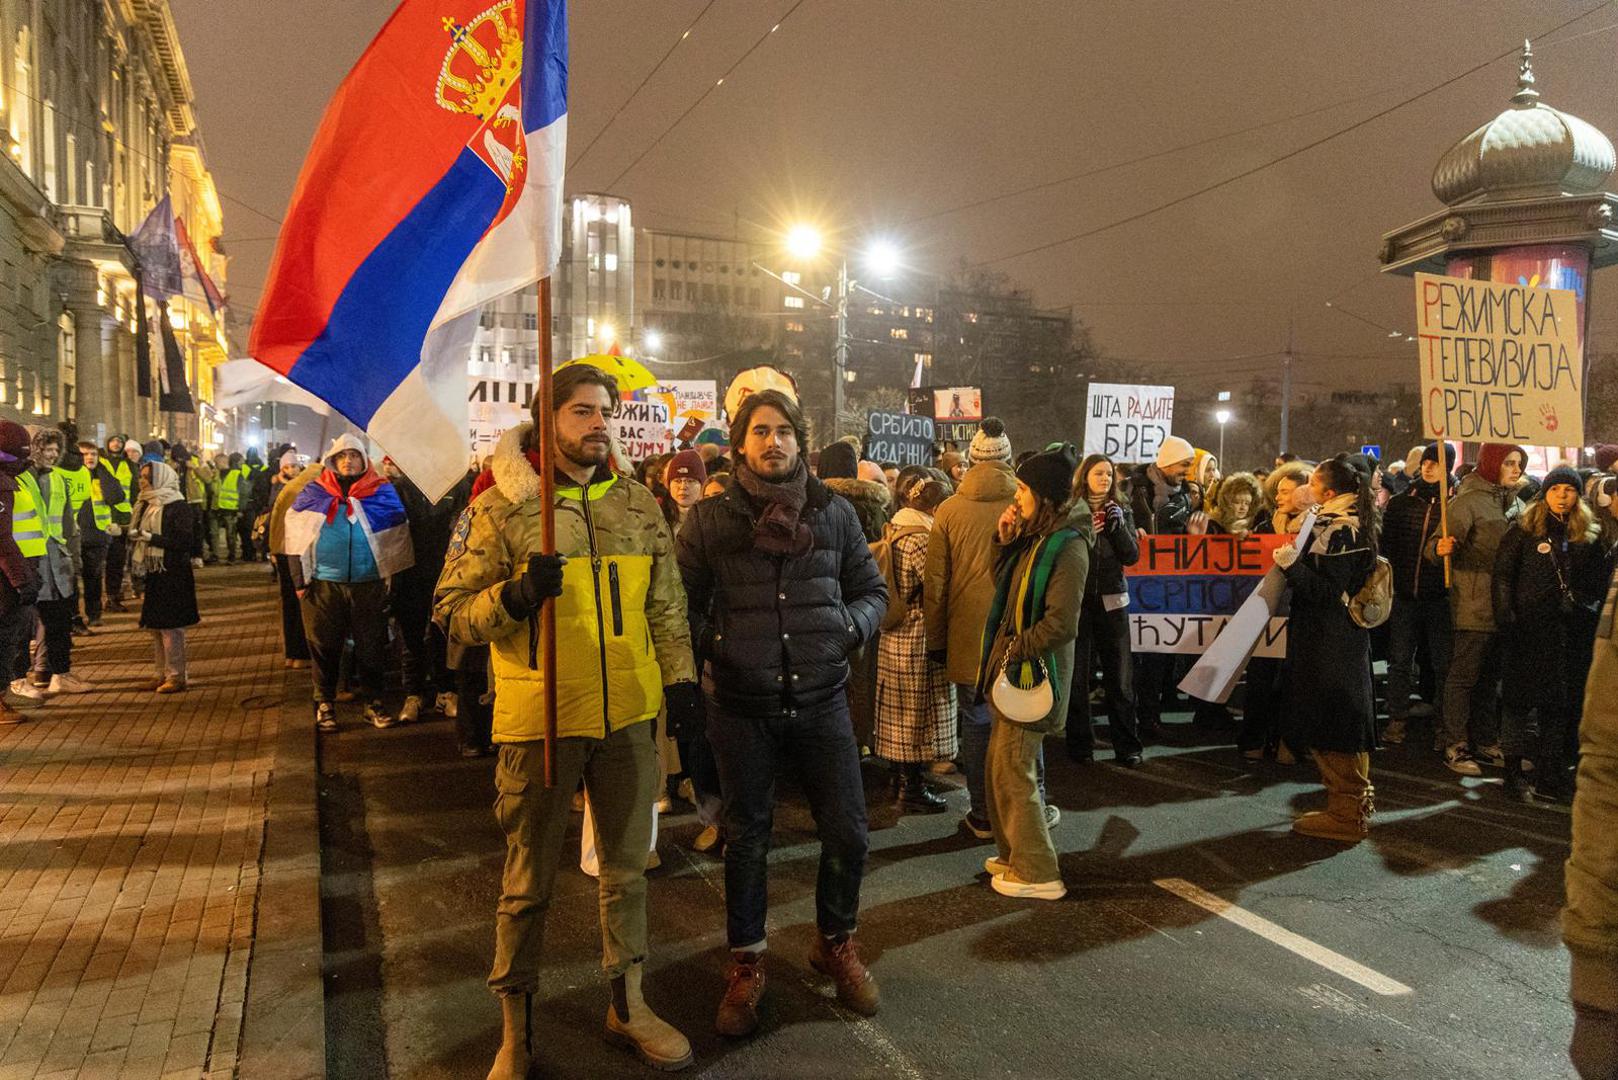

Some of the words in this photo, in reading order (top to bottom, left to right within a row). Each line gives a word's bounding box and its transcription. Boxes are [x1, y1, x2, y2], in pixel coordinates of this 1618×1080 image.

[1423, 280, 1559, 336] РЕЖИМСКА
[1092, 395, 1121, 418] ШТА
[1127, 396, 1173, 420] РАДИТЕ
[1428, 387, 1530, 440] СРБИЈЕ
[620, 426, 645, 439] ВАС
[869, 412, 933, 440] СРБИЈО
[1104, 424, 1165, 457] БРЕ?
[869, 440, 933, 467] ИЗДРЖИ
[1149, 537, 1261, 572] НИЈЕ
